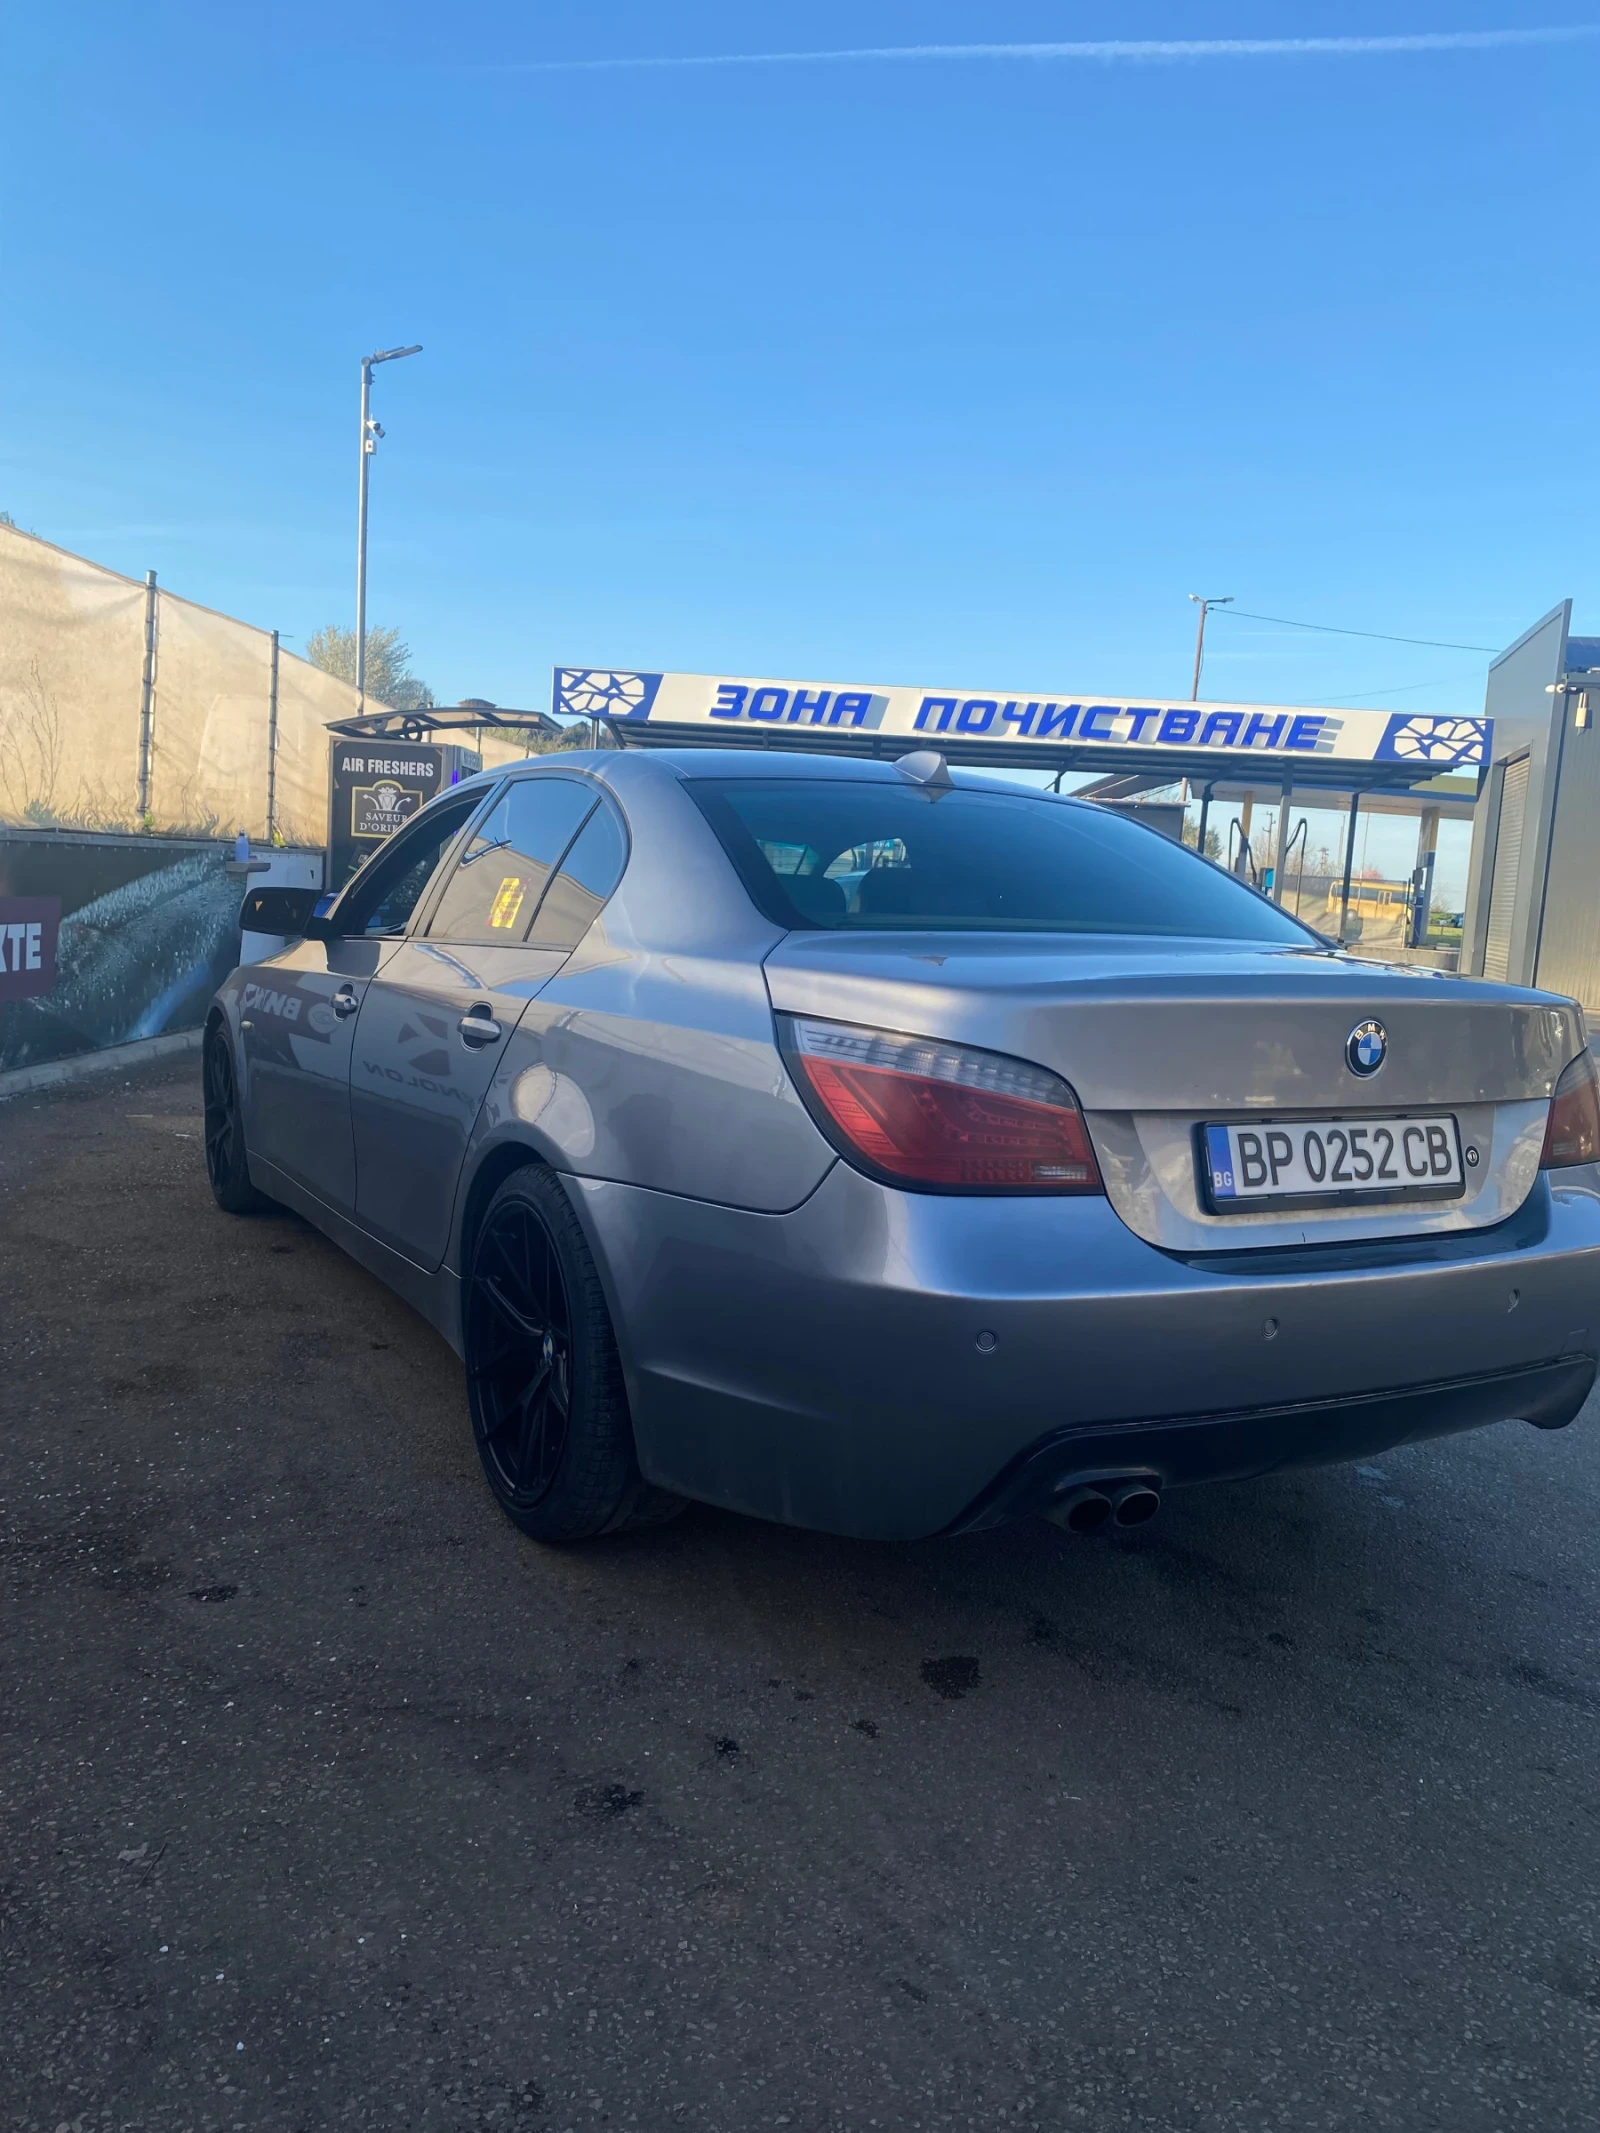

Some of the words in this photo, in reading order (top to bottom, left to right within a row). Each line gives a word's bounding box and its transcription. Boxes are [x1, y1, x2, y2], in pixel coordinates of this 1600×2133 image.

[709, 684, 873, 728] ЗОНА
[912, 696, 1328, 750] ПОЧИСТВАНЕ
[342, 757, 364, 772] AIR
[367, 759, 434, 777] FRESHERS
[0, 922, 42, 972] ТЕ
[1213, 1171, 1232, 1187] BG
[1237, 1131, 1293, 1187] BP
[1303, 1128, 1398, 1183] 0252
[1403, 1125, 1452, 1177] CB
